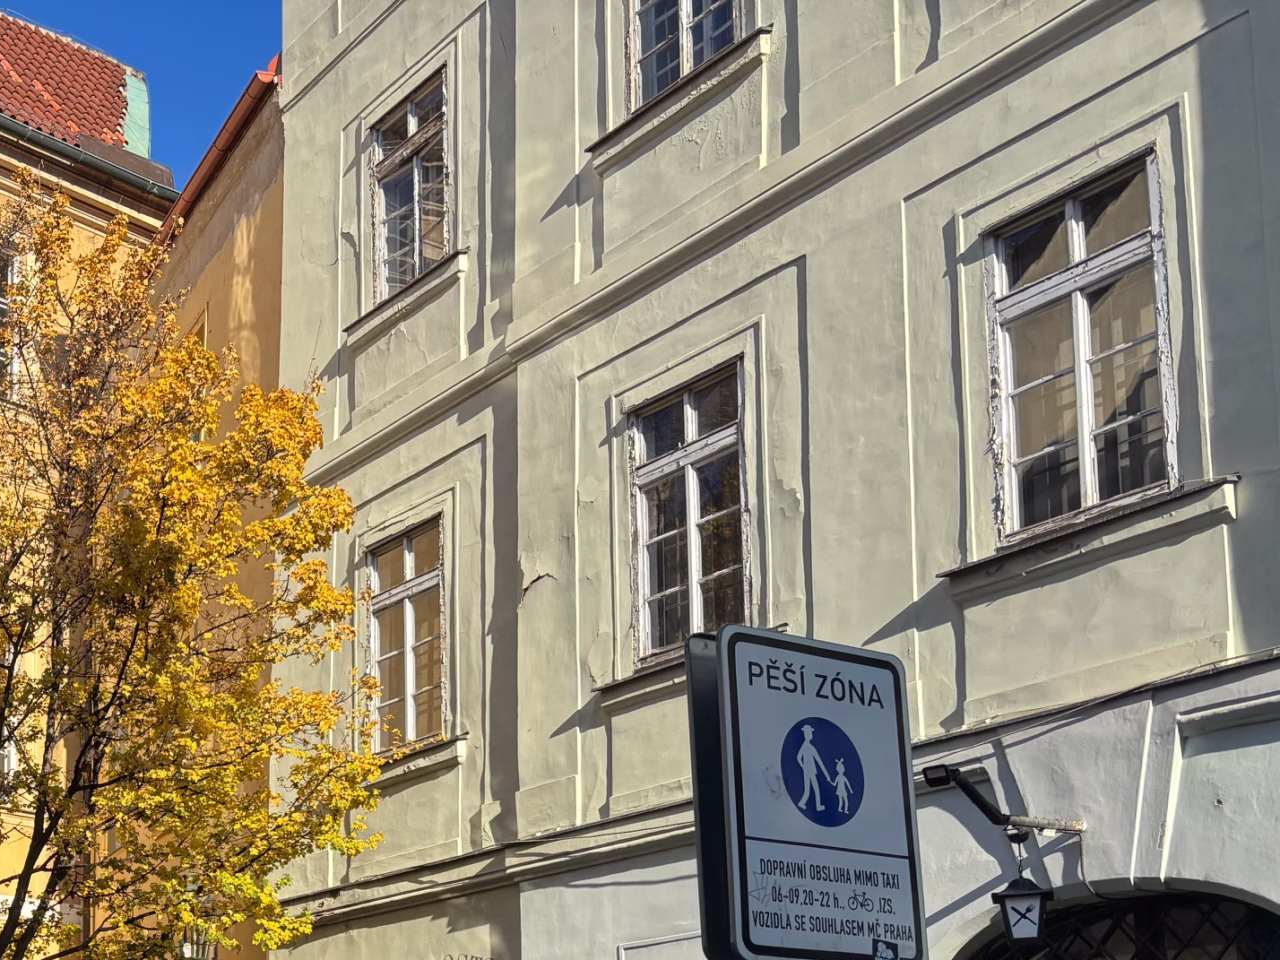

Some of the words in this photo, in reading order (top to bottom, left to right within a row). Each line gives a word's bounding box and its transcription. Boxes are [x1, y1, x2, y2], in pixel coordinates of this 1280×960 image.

[748, 658, 806, 696] PĚŠÍ
[814, 671, 885, 710] ZÓNA
[759, 858, 807, 880] DOPRAVNÍ
[809, 863, 852, 885] OBSLUHA
[854, 869, 880, 888] MIMO
[880, 872, 901, 890] TAXI
[751, 910, 793, 931] VOZIDLA
[794, 914, 806, 932] SE
[809, 915, 865, 938] SOUHLASEM
[867, 918, 882, 939] MČ
[883, 922, 914, 942] PRAHA
